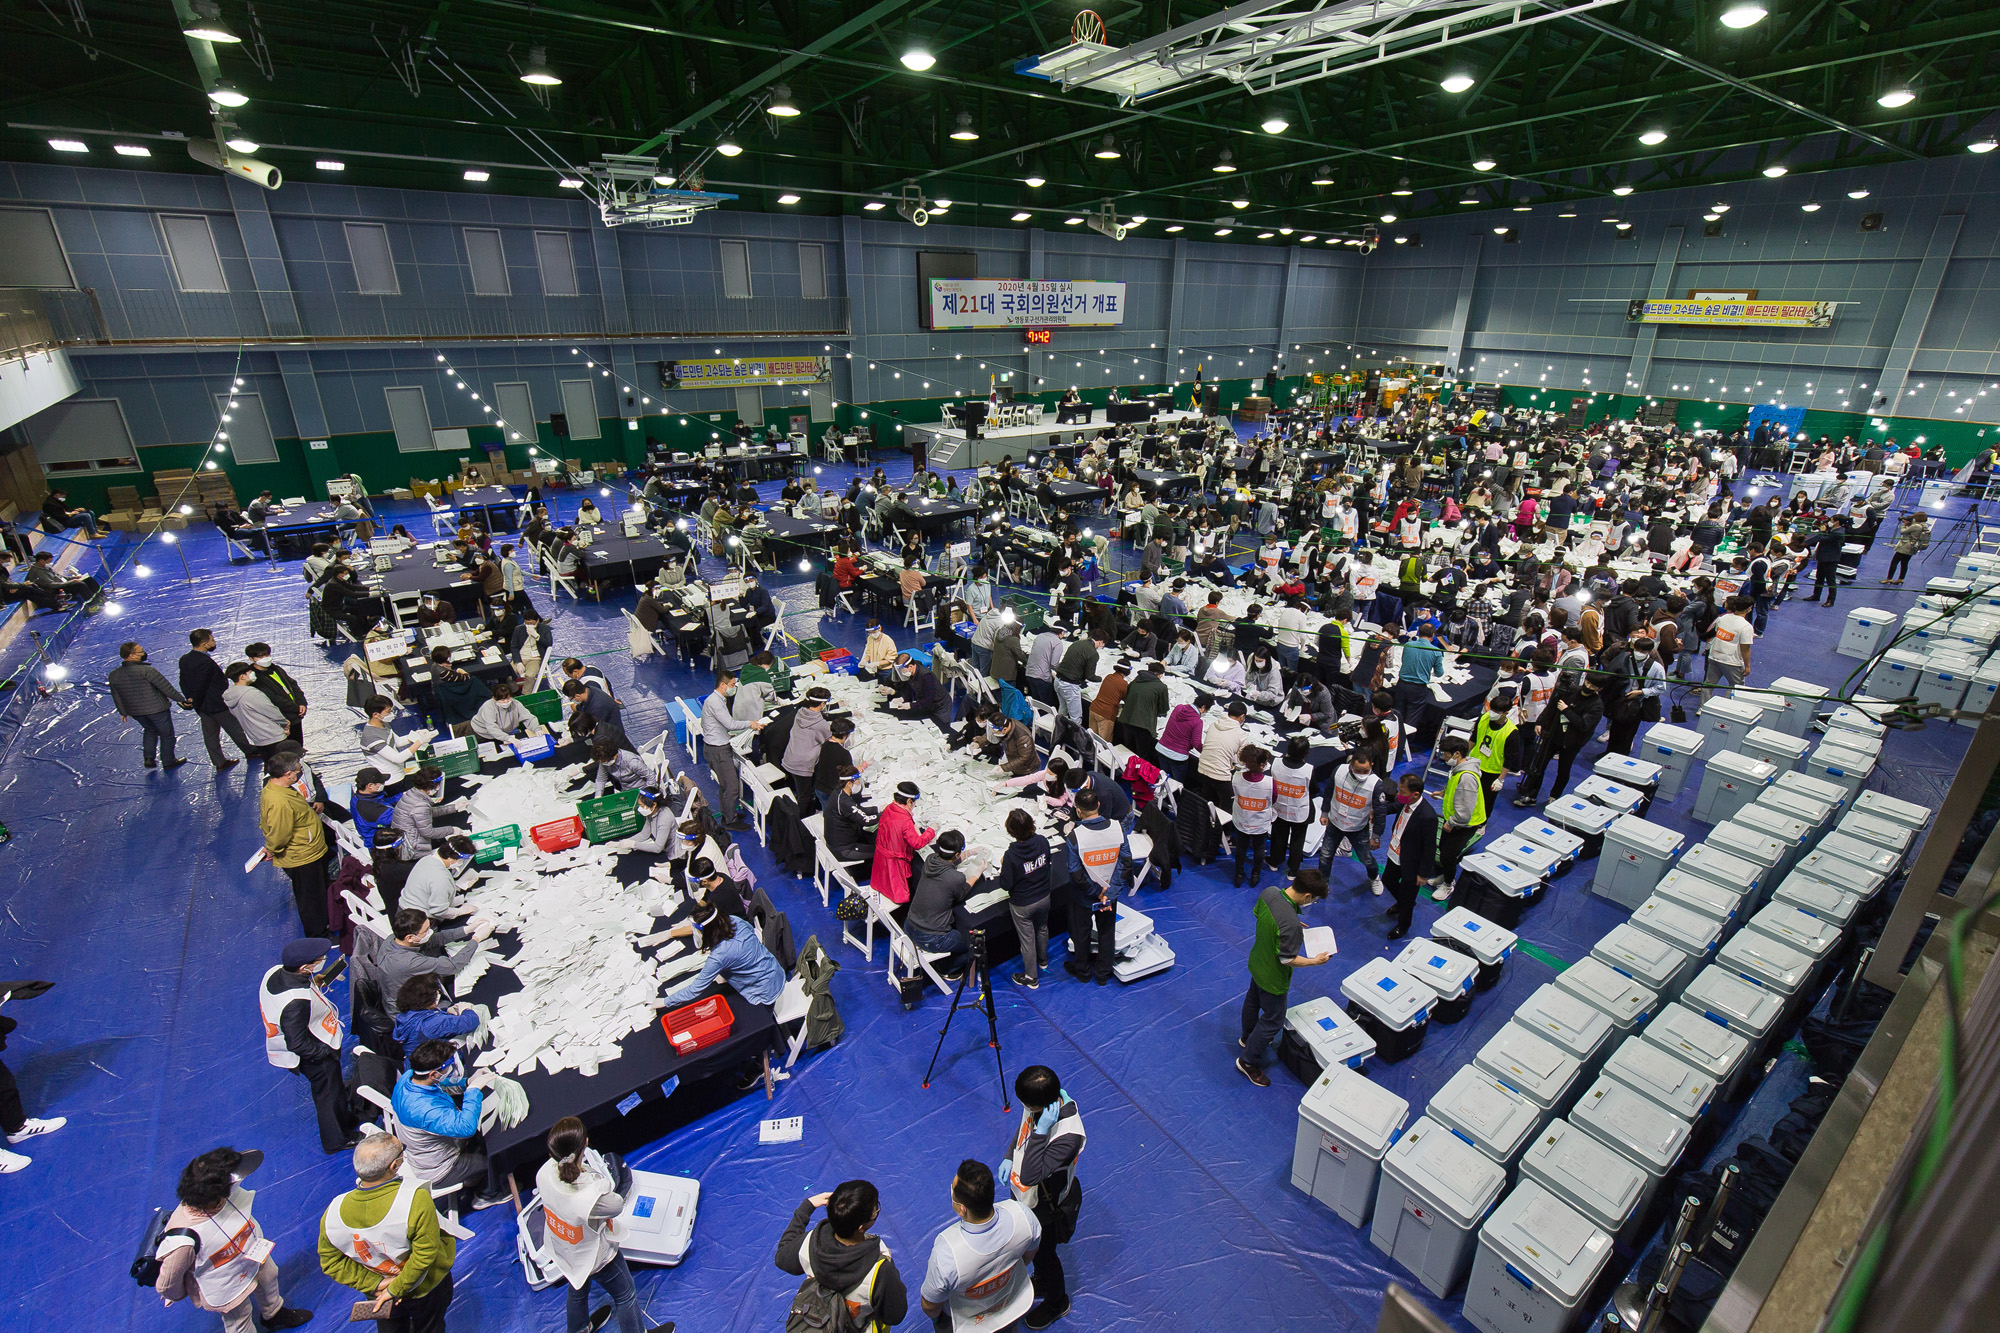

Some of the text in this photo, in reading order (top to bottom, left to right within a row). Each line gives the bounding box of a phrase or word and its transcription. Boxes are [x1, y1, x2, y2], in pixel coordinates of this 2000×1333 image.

[997, 282, 1073, 293] 2020년 4월 15일 실시
[942, 293, 1118, 315] 제21대 국회의원선거 개표
[1642, 303, 1814, 318] 배드민턴 고수되는 숨은 비결!! 배드민턴 필라테스
[1028, 330, 1051, 343] 7:42
[674, 364, 704, 379] 배드민턴
[704, 363, 733, 378] 고수되는
[733, 362, 747, 377] 숨은
[767, 361, 794, 375] 배드민턴
[1087, 851, 1117, 863] 개표참관
[1490, 1285, 1535, 1324] 투표함
